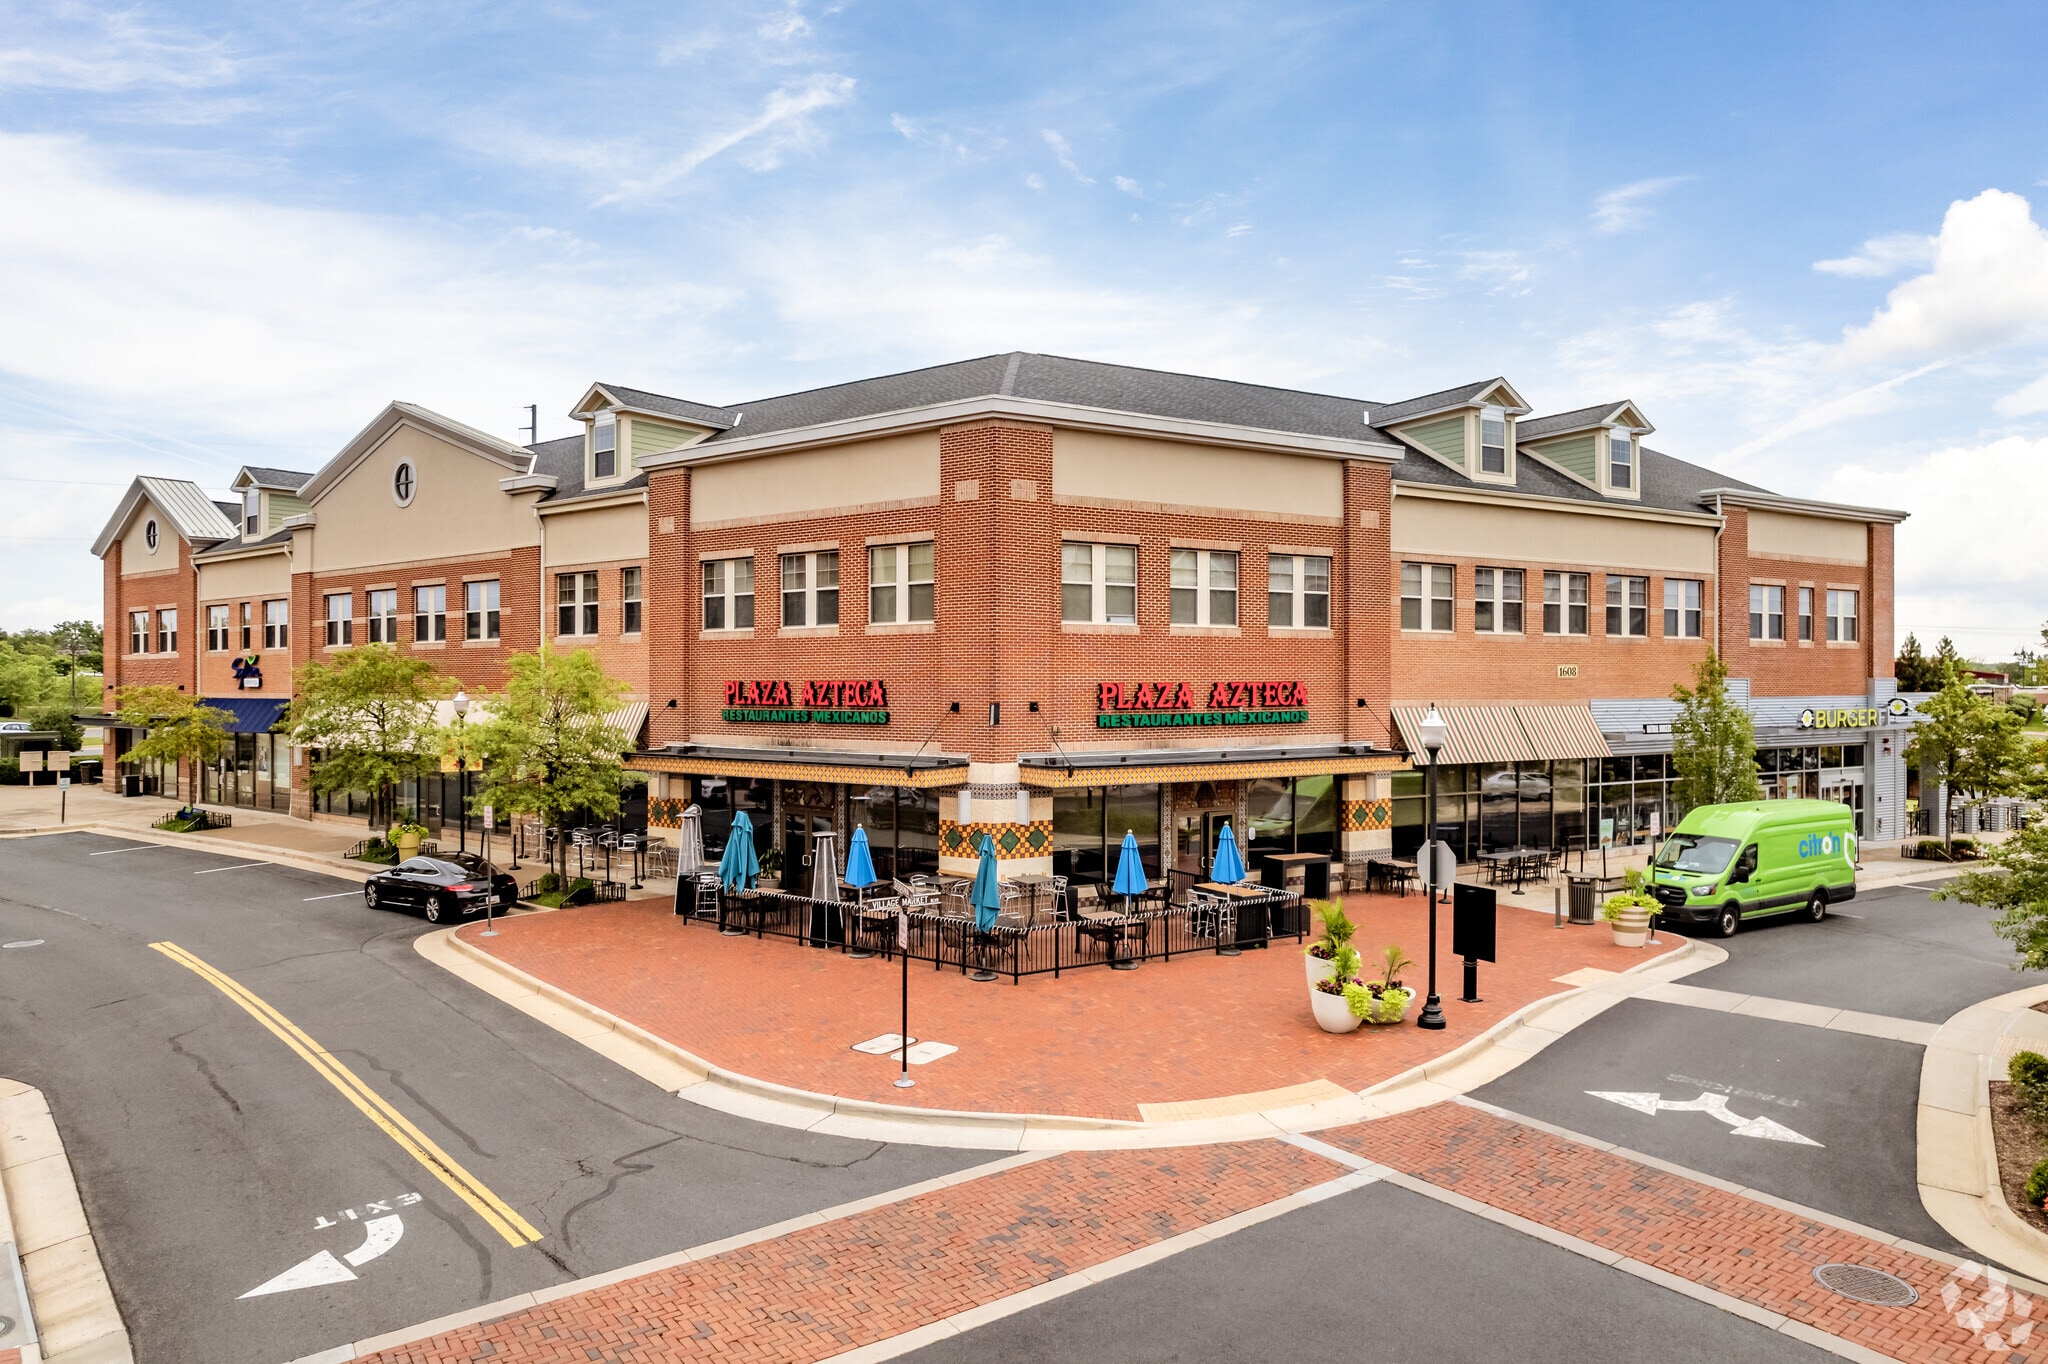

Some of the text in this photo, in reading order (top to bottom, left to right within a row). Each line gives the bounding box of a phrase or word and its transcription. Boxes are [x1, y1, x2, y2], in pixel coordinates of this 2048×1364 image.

[1559, 666, 1577, 677] 1608
[724, 680, 885, 707] PLAZA AZTECA
[1099, 681, 1309, 709] PLAZA AZTECA
[722, 709, 888, 724] RESTAURANTES MEXICANOS
[1099, 710, 1309, 728] RESTAURANTES MEXICANOS
[872, 899, 899, 910] VILLAGE
[901, 896, 928, 907] MARKET
[314, 1192, 423, 1230] EXIT
